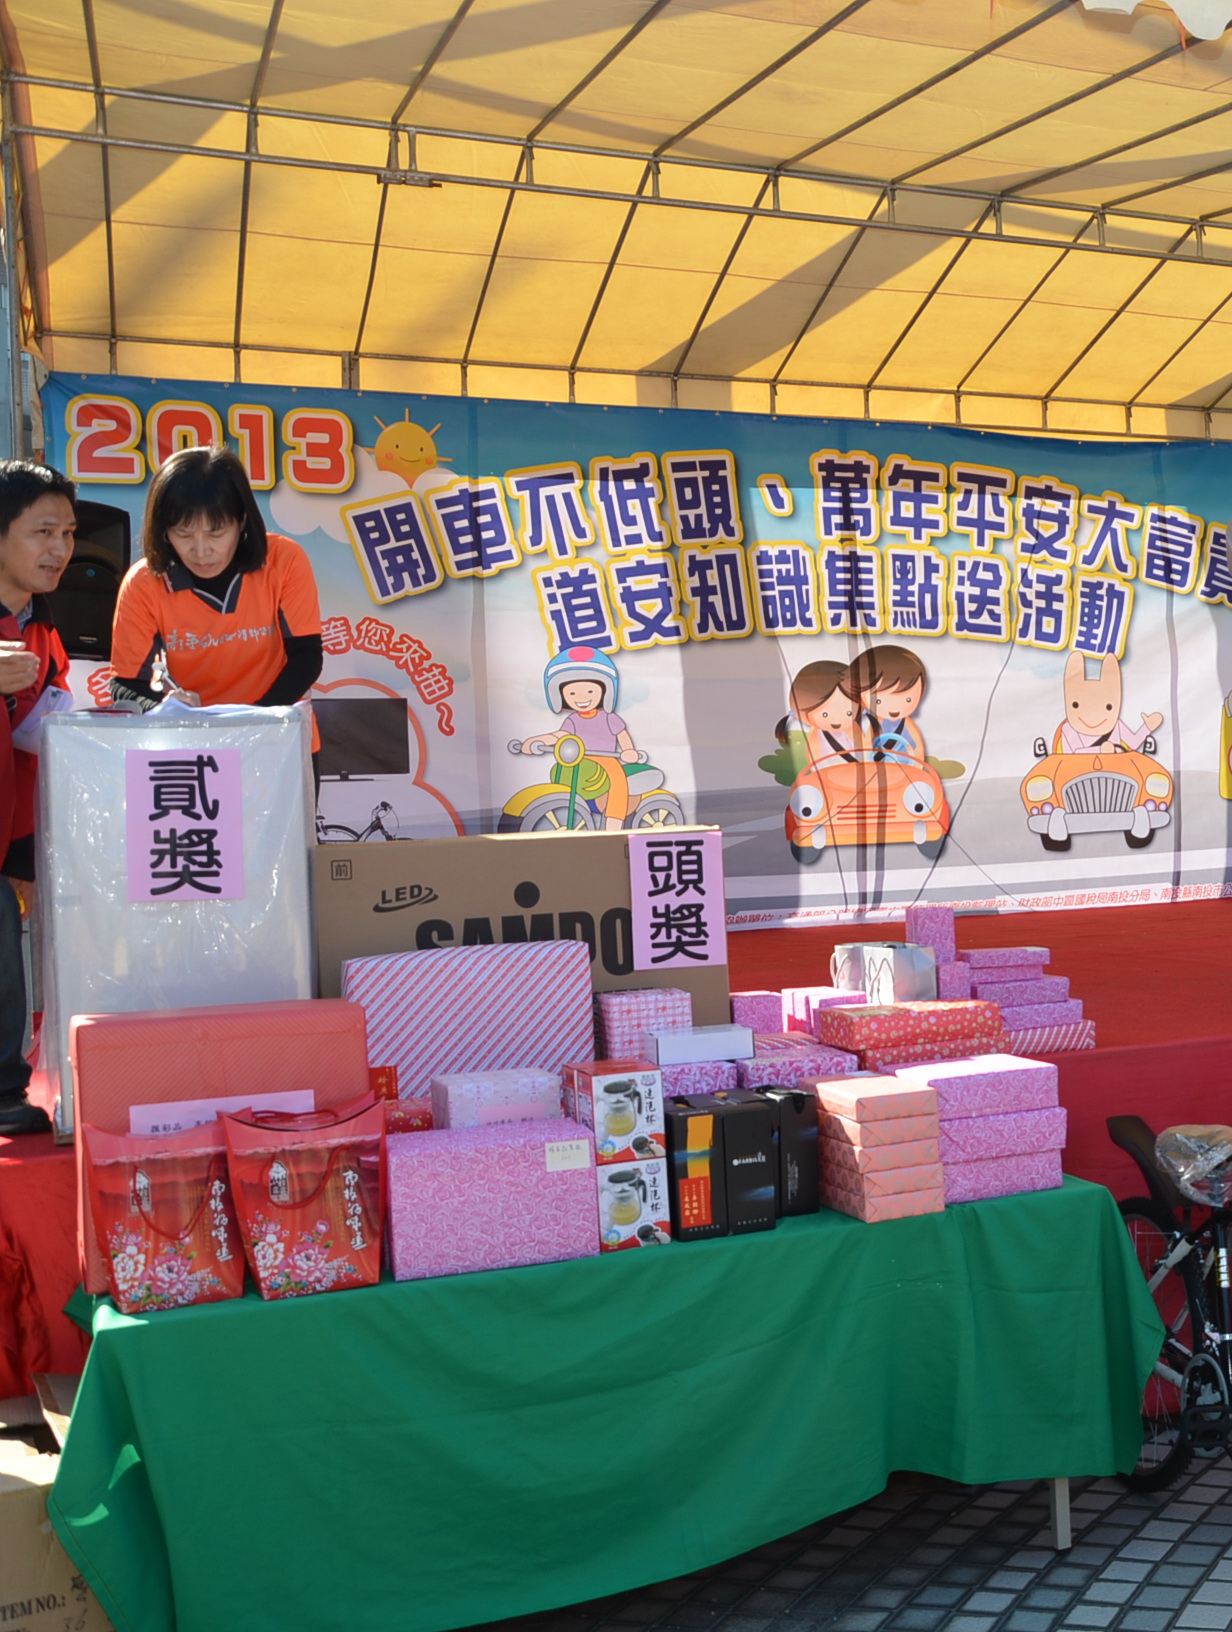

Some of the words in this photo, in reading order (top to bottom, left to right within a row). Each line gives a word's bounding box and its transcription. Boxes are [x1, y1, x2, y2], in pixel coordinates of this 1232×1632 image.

[67, 396, 353, 494] 2013
[540, 537, 1133, 658] 道安知識集點送活動
[148, 754, 223, 896] 貳獎
[332, 861, 352, 879] 前
[380, 884, 423, 904] LED
[645, 838, 710, 965] 頭獎
